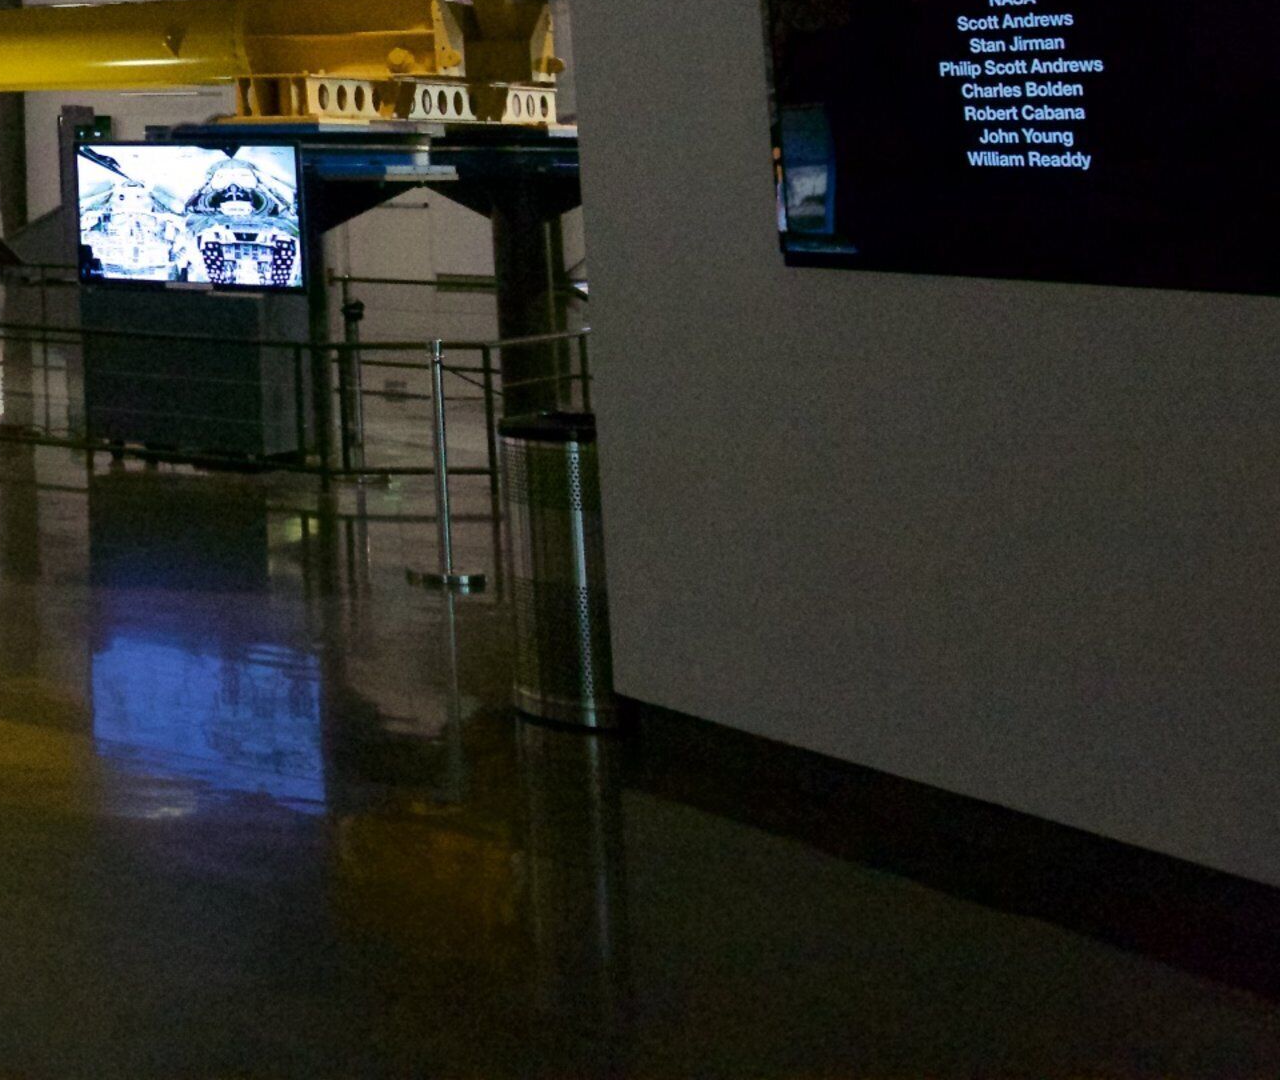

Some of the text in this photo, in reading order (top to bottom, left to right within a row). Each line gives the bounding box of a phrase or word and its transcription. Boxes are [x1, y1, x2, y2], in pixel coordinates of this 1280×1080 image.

[957, 12, 1074, 31] Scott Andrews
[970, 35, 1065, 54] Stan Jirman
[940, 58, 1104, 78] Philip Scott Andrews
[961, 81, 1083, 98] Charles Bolden
[964, 105, 1085, 121] Robert Cabana
[979, 128, 1074, 147] John Young
[967, 151, 1091, 170] William Readdy
